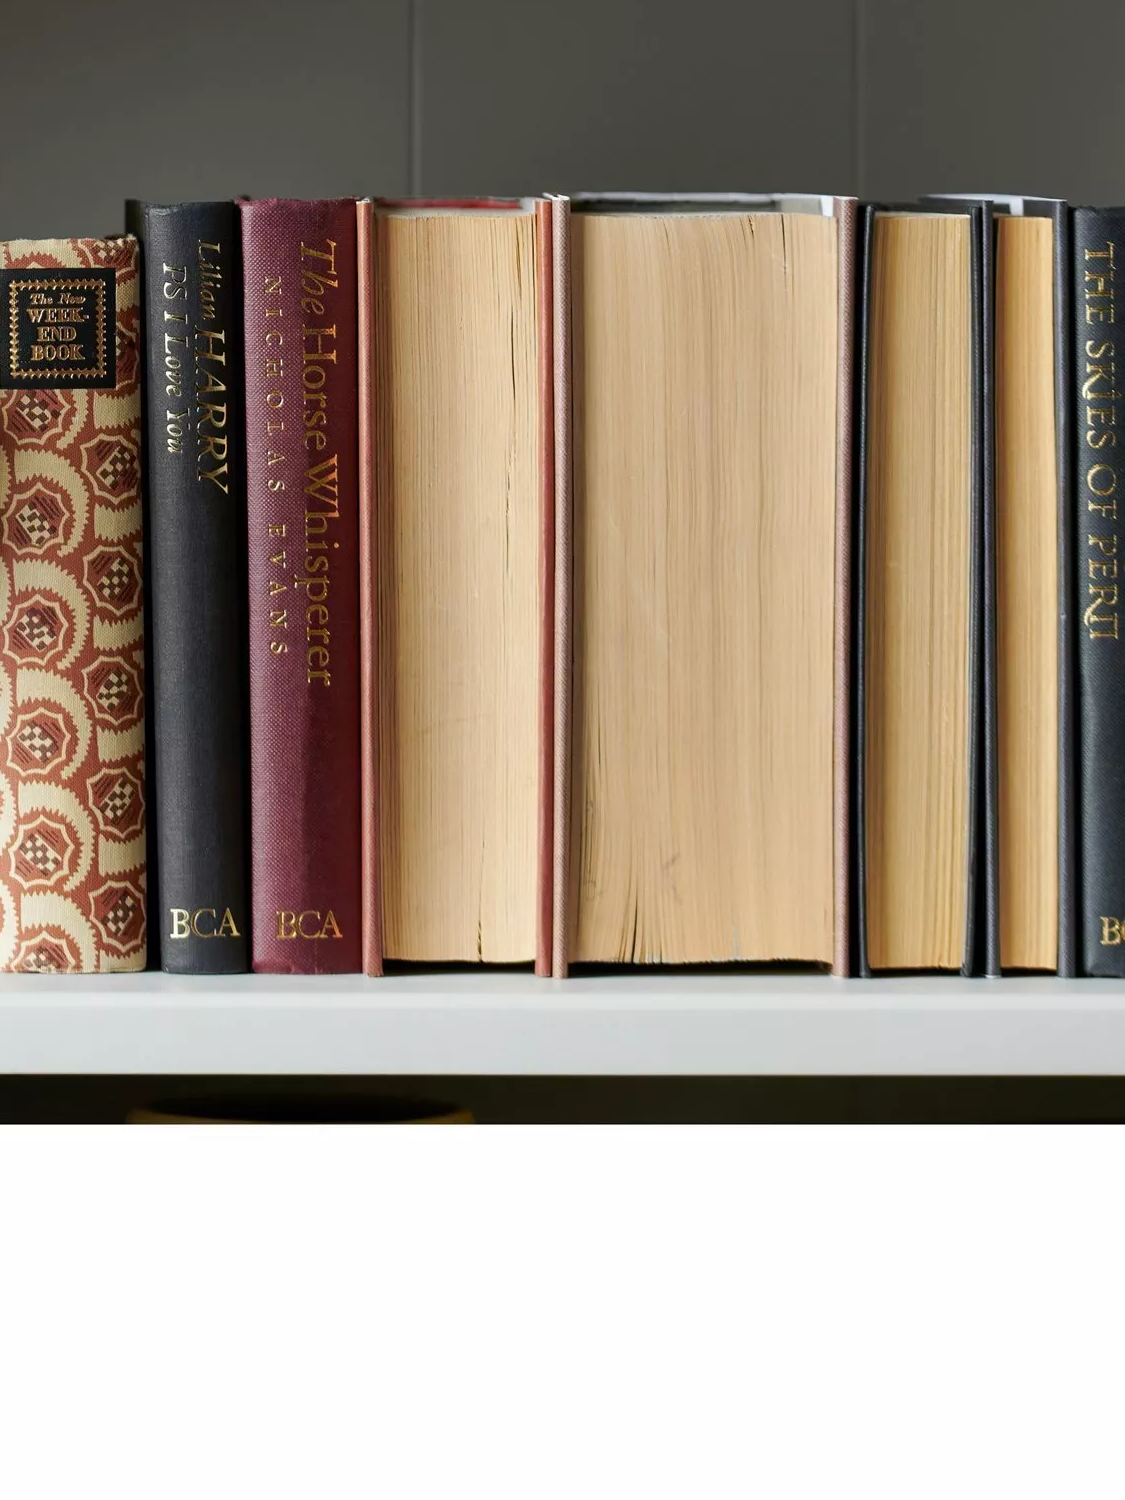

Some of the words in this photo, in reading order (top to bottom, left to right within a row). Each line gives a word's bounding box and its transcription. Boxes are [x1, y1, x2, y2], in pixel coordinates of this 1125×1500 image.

[30, 293, 53, 305] The
[57, 292, 87, 305] New
[162, 262, 189, 301] PS
[197, 239, 222, 320] Lilian
[300, 238, 338, 315] The
[1084, 241, 1115, 325] THE
[26, 307, 90, 324] WEEK-
[37, 326, 77, 342] END
[163, 310, 189, 325] I
[30, 344, 86, 361] BOOK
[164, 333, 189, 398] Love
[193, 325, 229, 495] HARRY
[263, 275, 285, 492] NICHOLAS
[301, 324, 338, 450] Horse
[1082, 340, 1117, 448] SKIES
[165, 407, 191, 455] You
[1086, 463, 1118, 518] OF
[267, 524, 289, 655] EVANS
[294, 454, 340, 687] Whisperer
[169, 907, 242, 939] BCA
[275, 909, 344, 940] BCA
